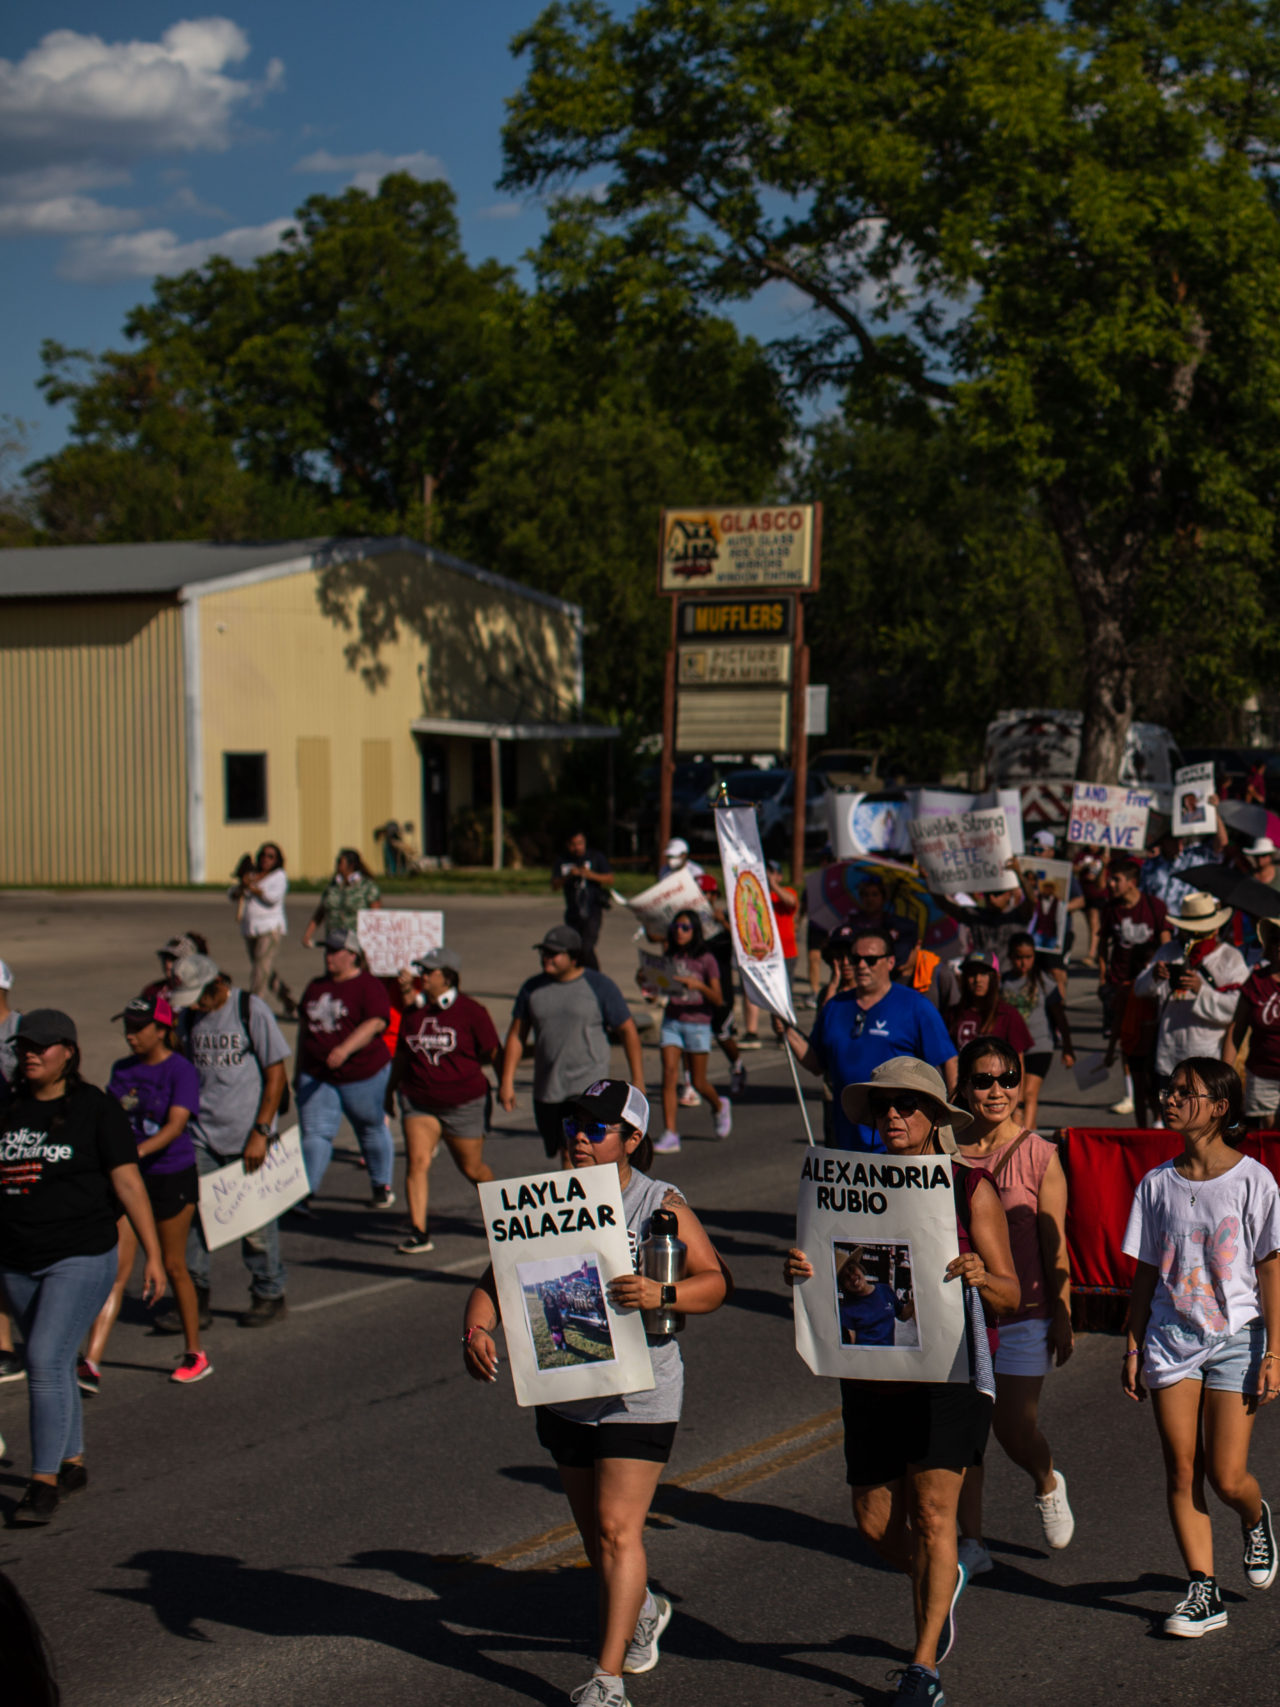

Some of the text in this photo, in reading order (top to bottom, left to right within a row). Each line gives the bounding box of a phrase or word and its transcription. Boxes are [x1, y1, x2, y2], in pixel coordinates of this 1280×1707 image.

[720, 511, 803, 533] GLASCO
[694, 602, 784, 633] MUFFLERS
[712, 649, 778, 662] PICTURE
[1074, 784, 1107, 802] LAND
[1072, 805, 1111, 825] HOME
[1069, 820, 1140, 848] BRAVE
[193, 1034, 241, 1049] VALDE
[0, 1127, 48, 1146] olicy
[4, 1144, 75, 1163] Change
[801, 1156, 950, 1190] ALEXANDRIA
[501, 1177, 586, 1211] LAYLA
[817, 1186, 887, 1215] RUBIO
[492, 1204, 616, 1241] SALAZAR
